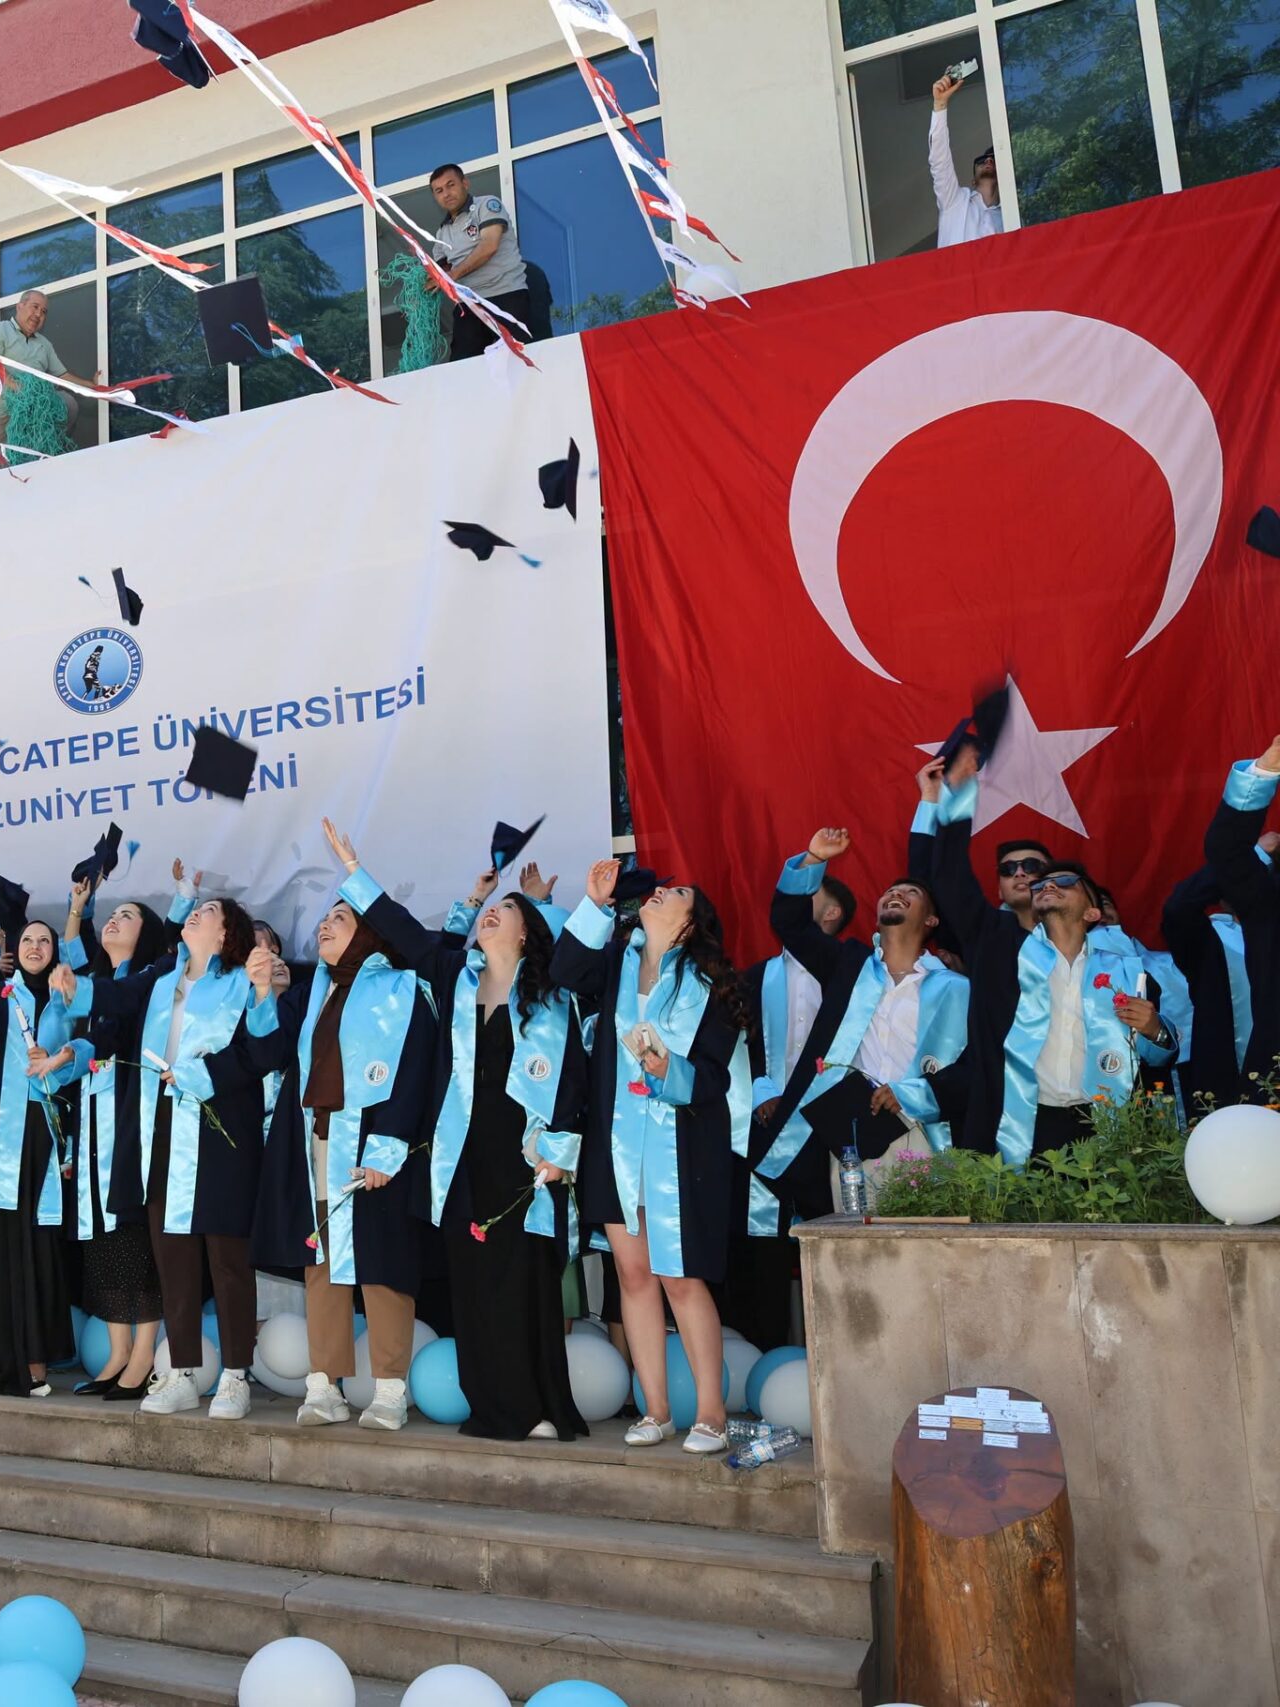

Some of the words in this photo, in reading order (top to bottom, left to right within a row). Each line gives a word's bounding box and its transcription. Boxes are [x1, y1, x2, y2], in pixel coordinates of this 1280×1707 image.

[59, 630, 102, 667] KOCATEPE
[57, 672, 73, 701] AFYON
[88, 702, 111, 712] 1992
[147, 752, 298, 806] TÖNİ
